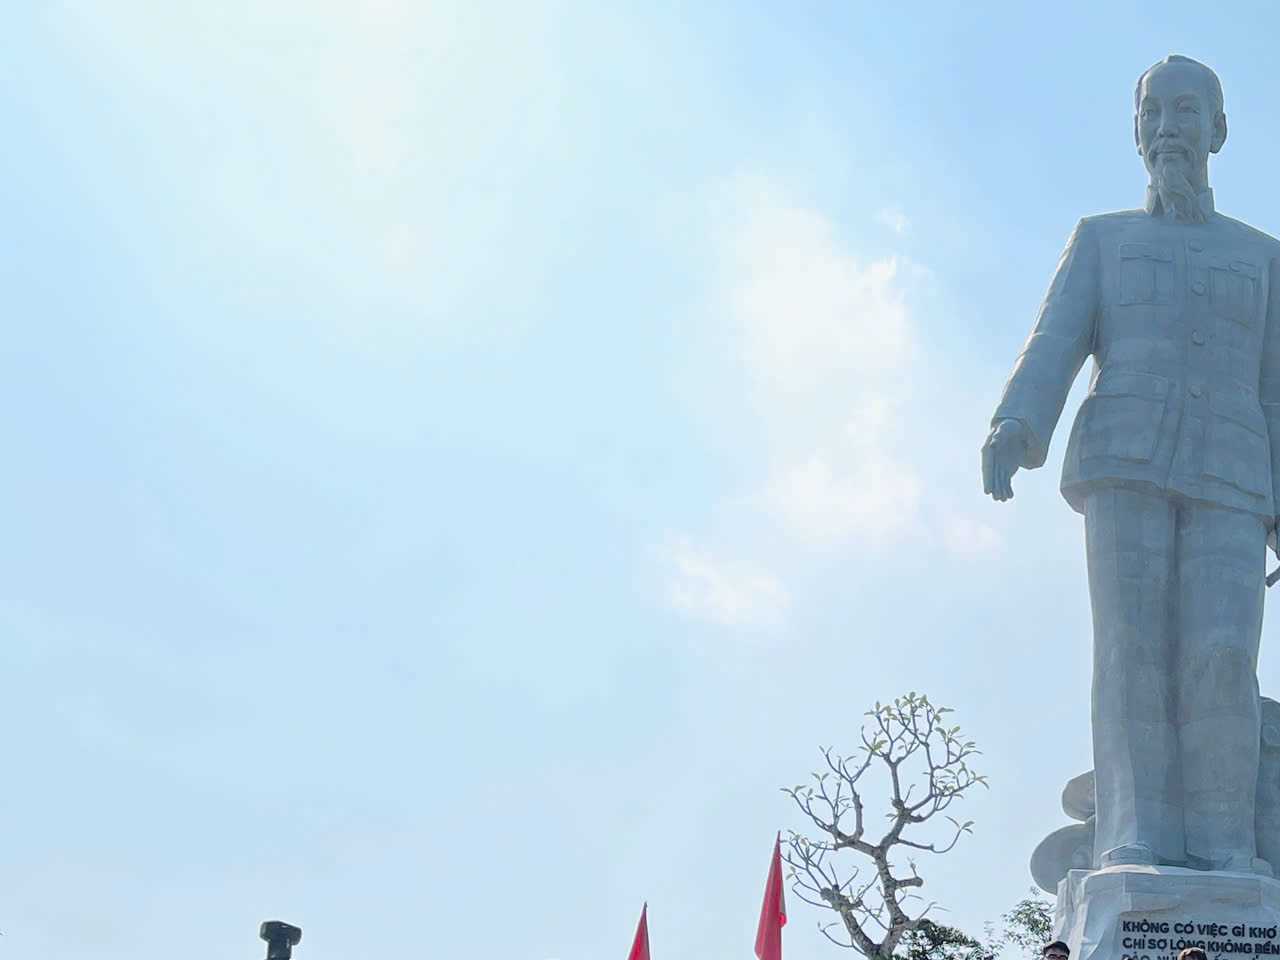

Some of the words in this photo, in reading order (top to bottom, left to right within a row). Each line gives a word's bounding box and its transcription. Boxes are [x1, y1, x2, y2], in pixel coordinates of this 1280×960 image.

[1122, 919, 1169, 934] KHÔNG
[1174, 920, 1194, 934] CÓ
[1197, 923, 1228, 938] VIỆC
[1232, 924, 1245, 937] GÌ
[1249, 925, 1277, 939] KHÓ
[1207, 939, 1252, 954] KHÔNG
